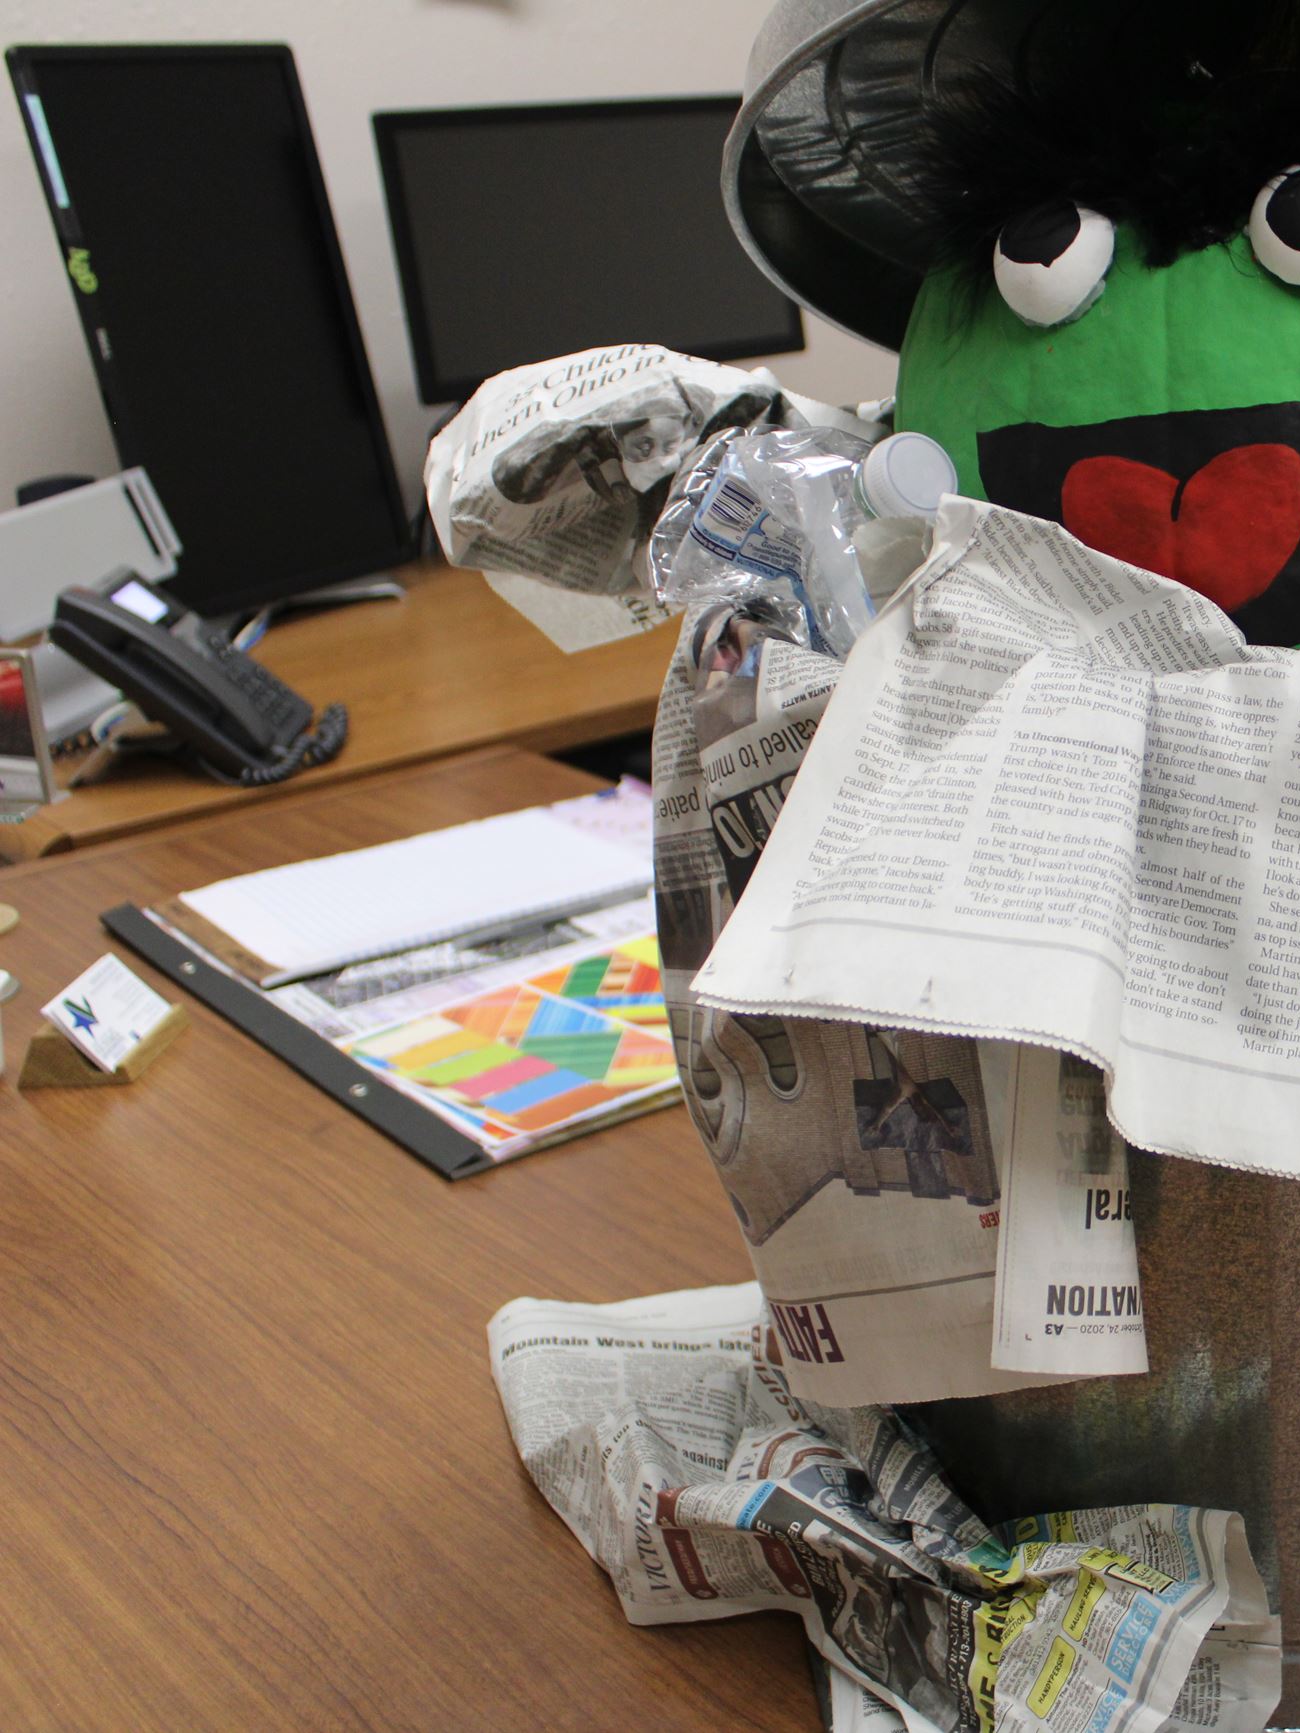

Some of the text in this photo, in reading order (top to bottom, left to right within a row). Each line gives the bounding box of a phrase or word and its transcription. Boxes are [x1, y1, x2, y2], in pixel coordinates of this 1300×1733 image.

[552, 367, 627, 408] Ohio
[634, 353, 666, 374] in
[781, 692, 806, 709] WATTS
[738, 744, 759, 768] to
[760, 718, 818, 764] called
[990, 819, 1112, 849] Fitch said he finds the
[1134, 873, 1242, 905] Second Amendment
[1140, 859, 1244, 891] almost half of the
[828, 889, 936, 909] most important to Ja-
[1247, 963, 1280, 976] could
[1245, 975, 1269, 989] date
[1271, 978, 1299, 996] than
[1243, 1037, 1285, 1055] Martin
[1044, 1323, 1064, 1336] A3
[1080, 1323, 1104, 1335] 2020
[502, 1335, 589, 1361] Mountain
[597, 1336, 645, 1350] West
[634, 1481, 671, 1592] VICTORIA
[1069, 1599, 1086, 1632] HAULING
[1111, 1601, 1148, 1670] SERVICE
[1122, 1611, 1155, 1676] DIRECTORY
[1037, 1652, 1066, 1705] HANDYPERSON
